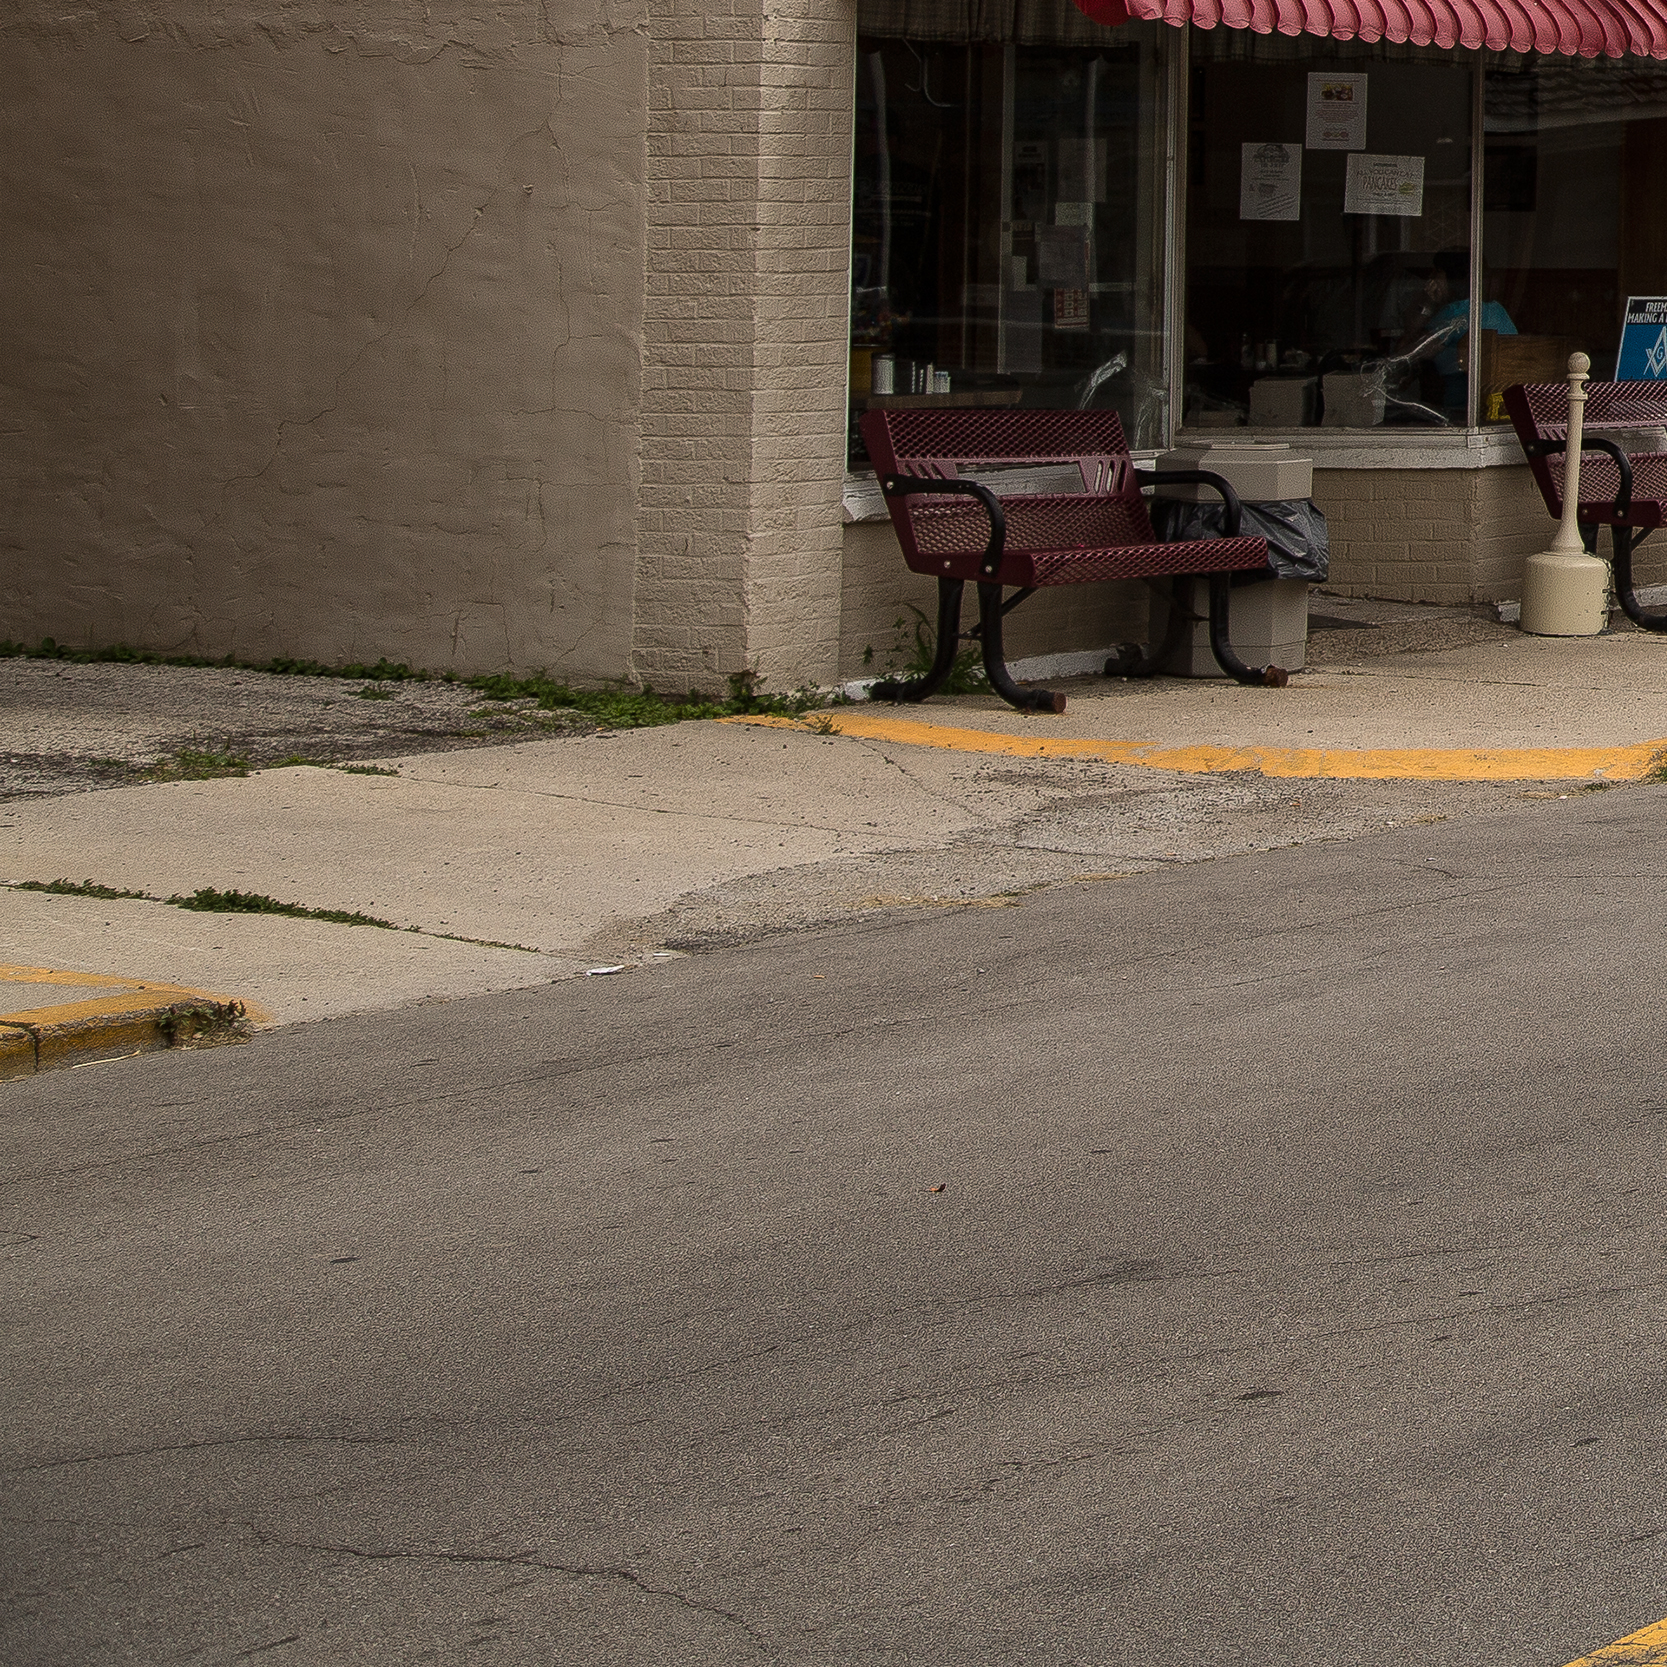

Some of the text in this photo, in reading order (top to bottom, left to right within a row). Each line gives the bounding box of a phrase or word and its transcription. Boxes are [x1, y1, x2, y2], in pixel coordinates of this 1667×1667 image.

[1627, 312, 1658, 323] MAKING
[1658, 312, 1665, 323] A
[1656, 345, 1664, 360] G
